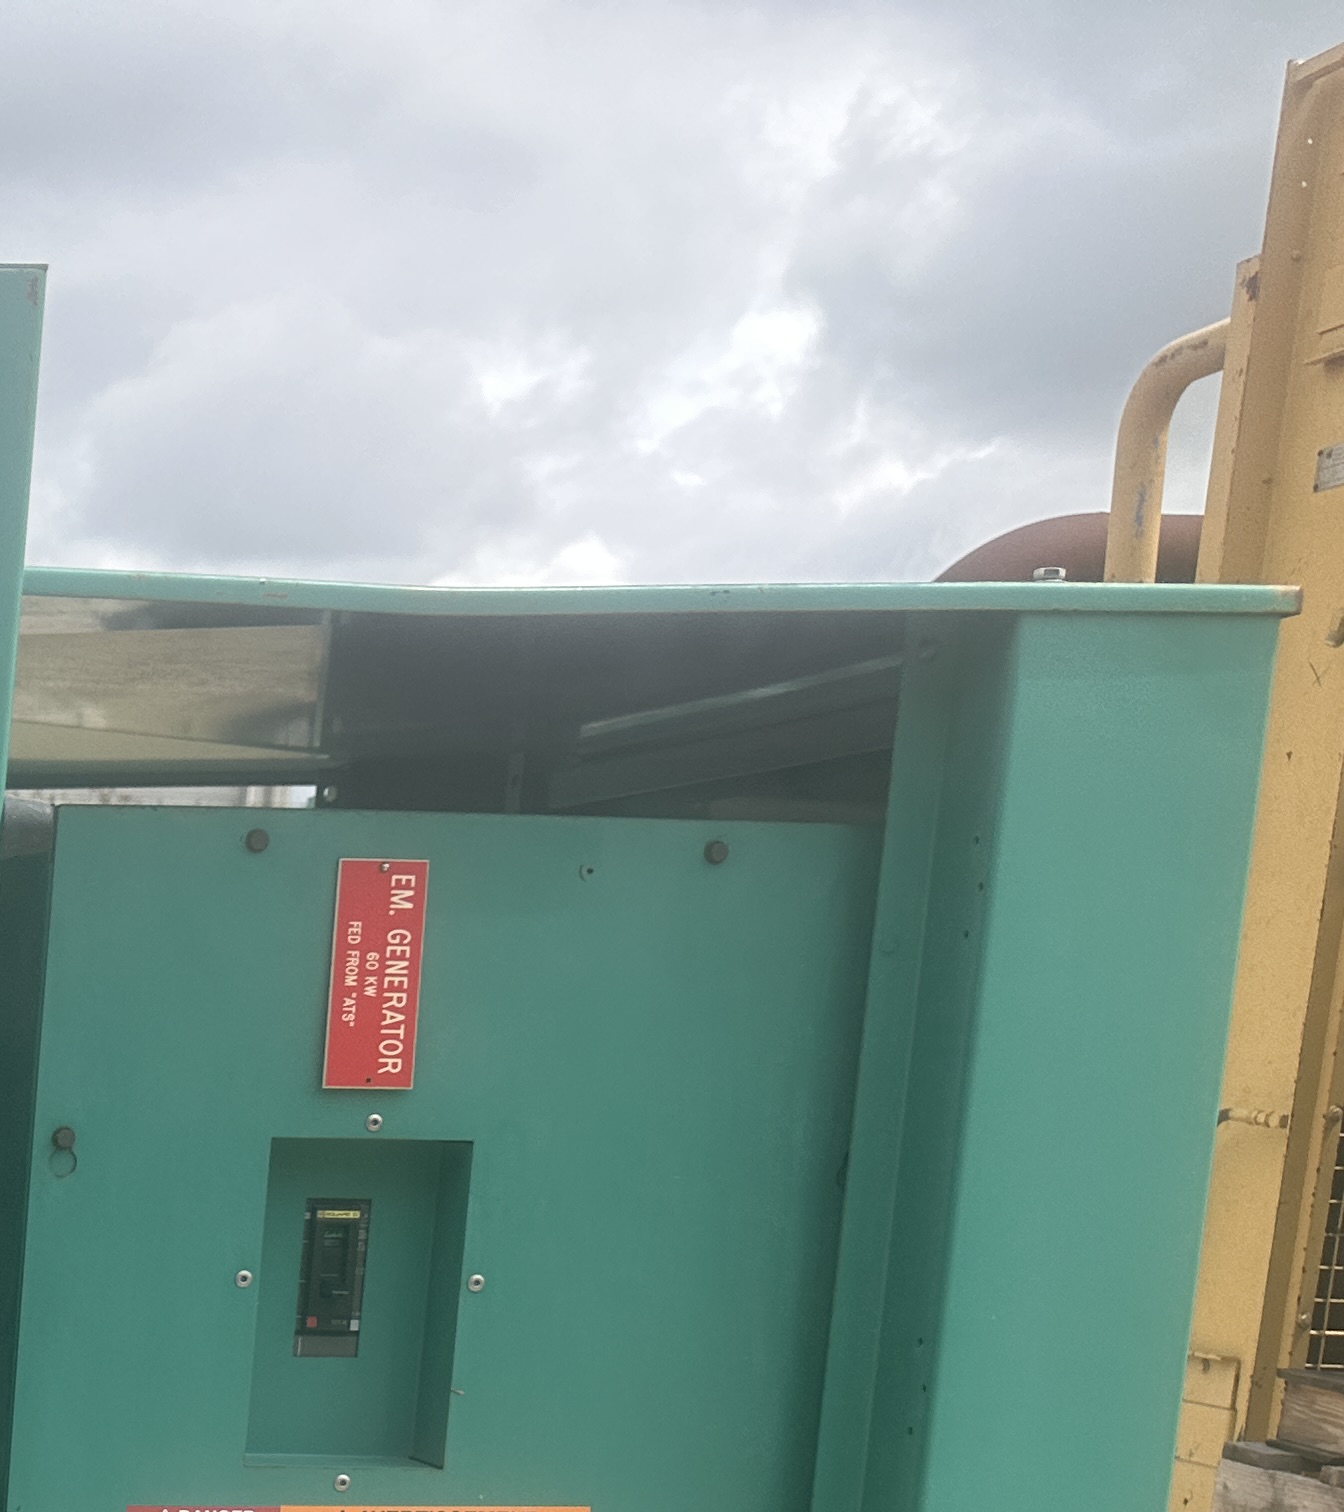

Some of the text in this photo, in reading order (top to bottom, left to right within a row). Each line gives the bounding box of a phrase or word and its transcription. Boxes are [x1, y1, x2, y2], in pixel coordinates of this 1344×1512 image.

[342, 921, 362, 1027] FED FROM "ATS"
[364, 952, 380, 998] 60 KW
[377, 875, 416, 1074] EM. GENERATOR
